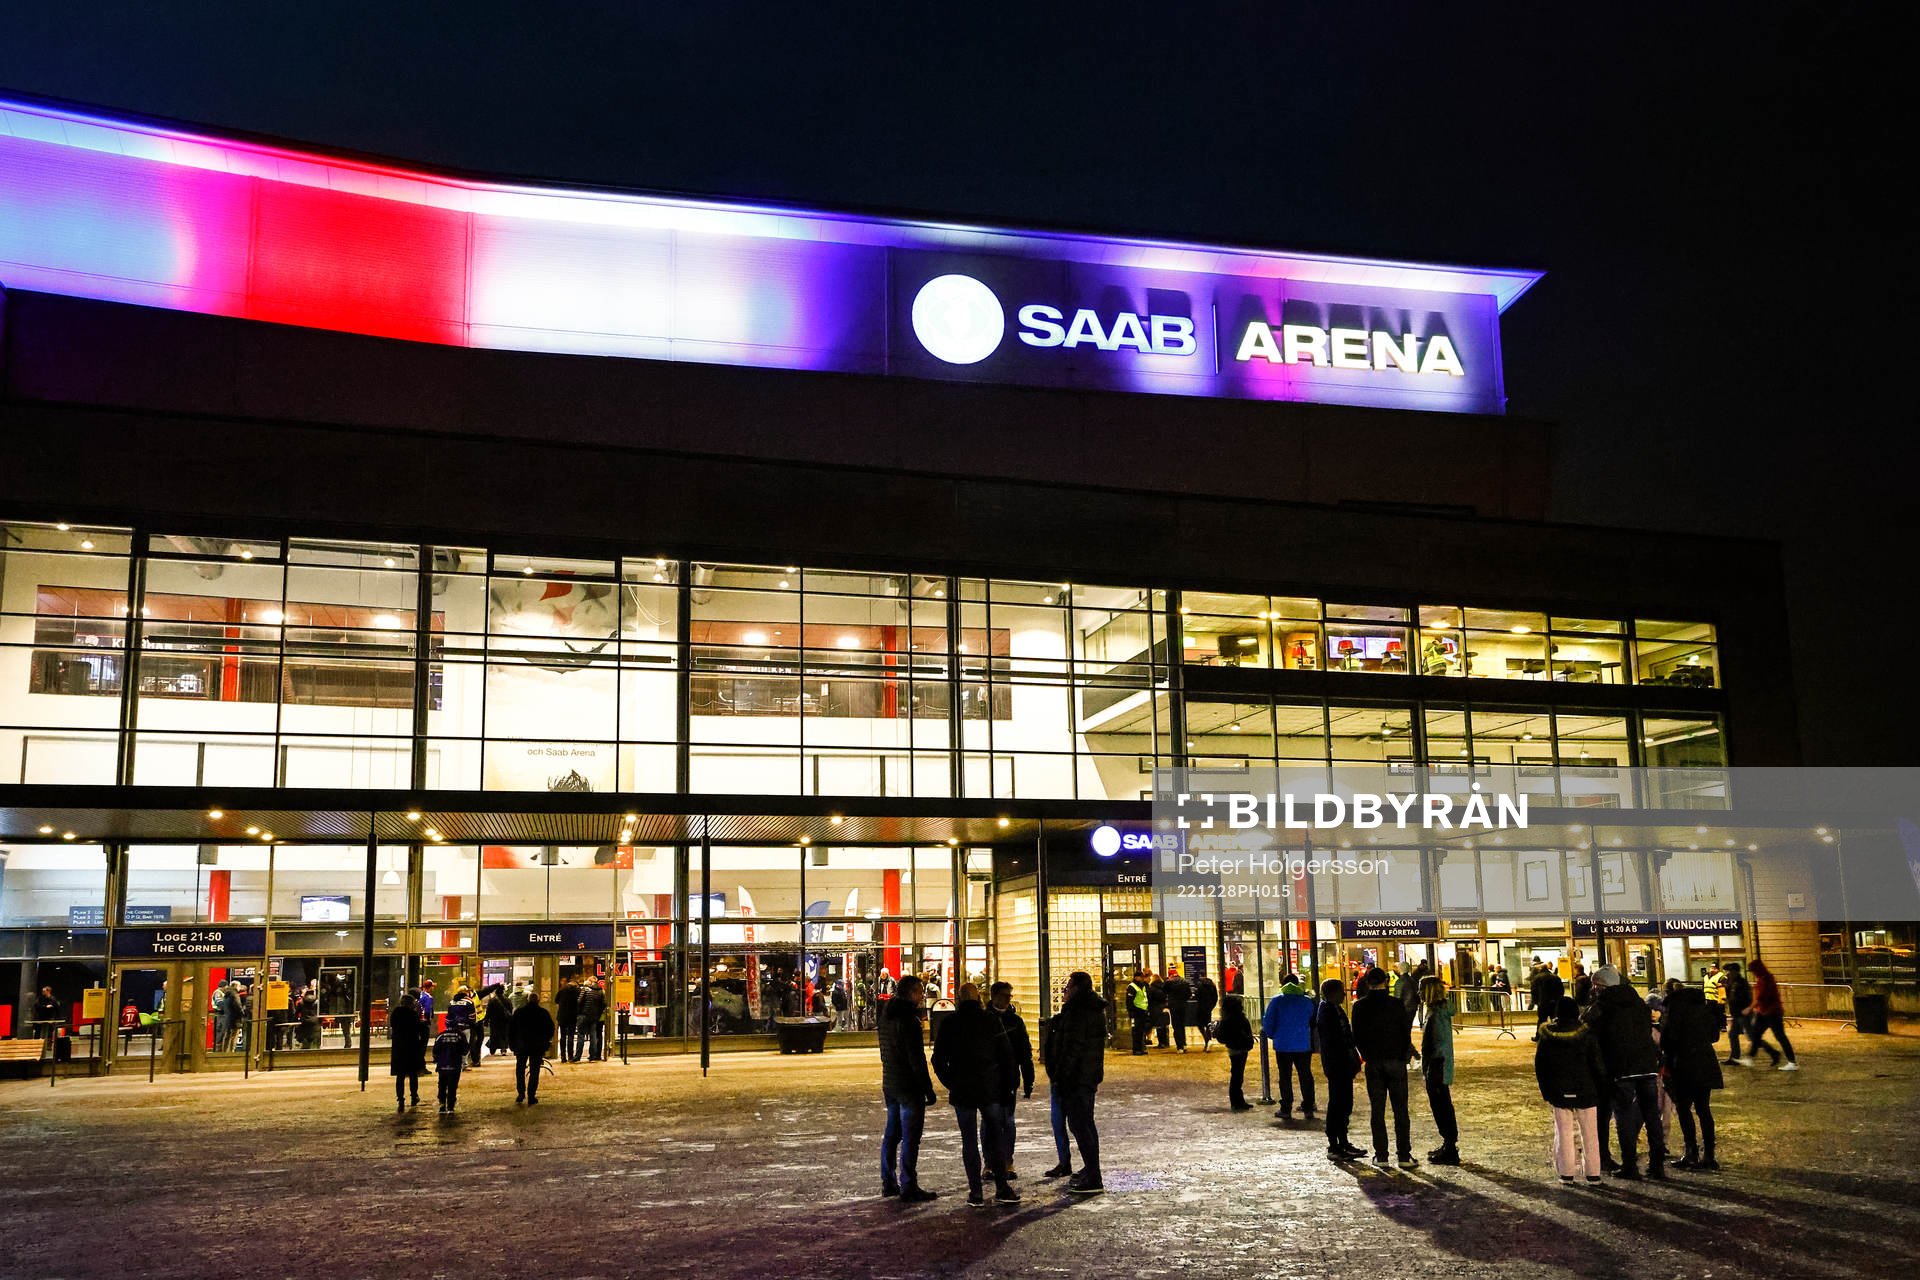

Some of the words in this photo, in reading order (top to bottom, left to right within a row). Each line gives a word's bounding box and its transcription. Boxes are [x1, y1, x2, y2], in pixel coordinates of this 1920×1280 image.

[1018, 304, 1198, 356] SAAB
[1235, 320, 1466, 377] ARENA
[527, 747, 544, 756] och
[546, 747, 569, 757] Saab
[571, 748, 596, 757] Arena
[1123, 834, 1179, 850] SAAB
[1117, 873, 1148, 883] ENTRÉ
[1665, 919, 1738, 930] KUNDCENTER
[156, 932, 188, 942] LOGE
[190, 931, 222, 942] 21-50
[1388, 927, 1420, 936] FÖRETAG
[529, 932, 562, 943] ENTRÉ
[152, 943, 175, 953] THE
[178, 942, 225, 953] CORNER
